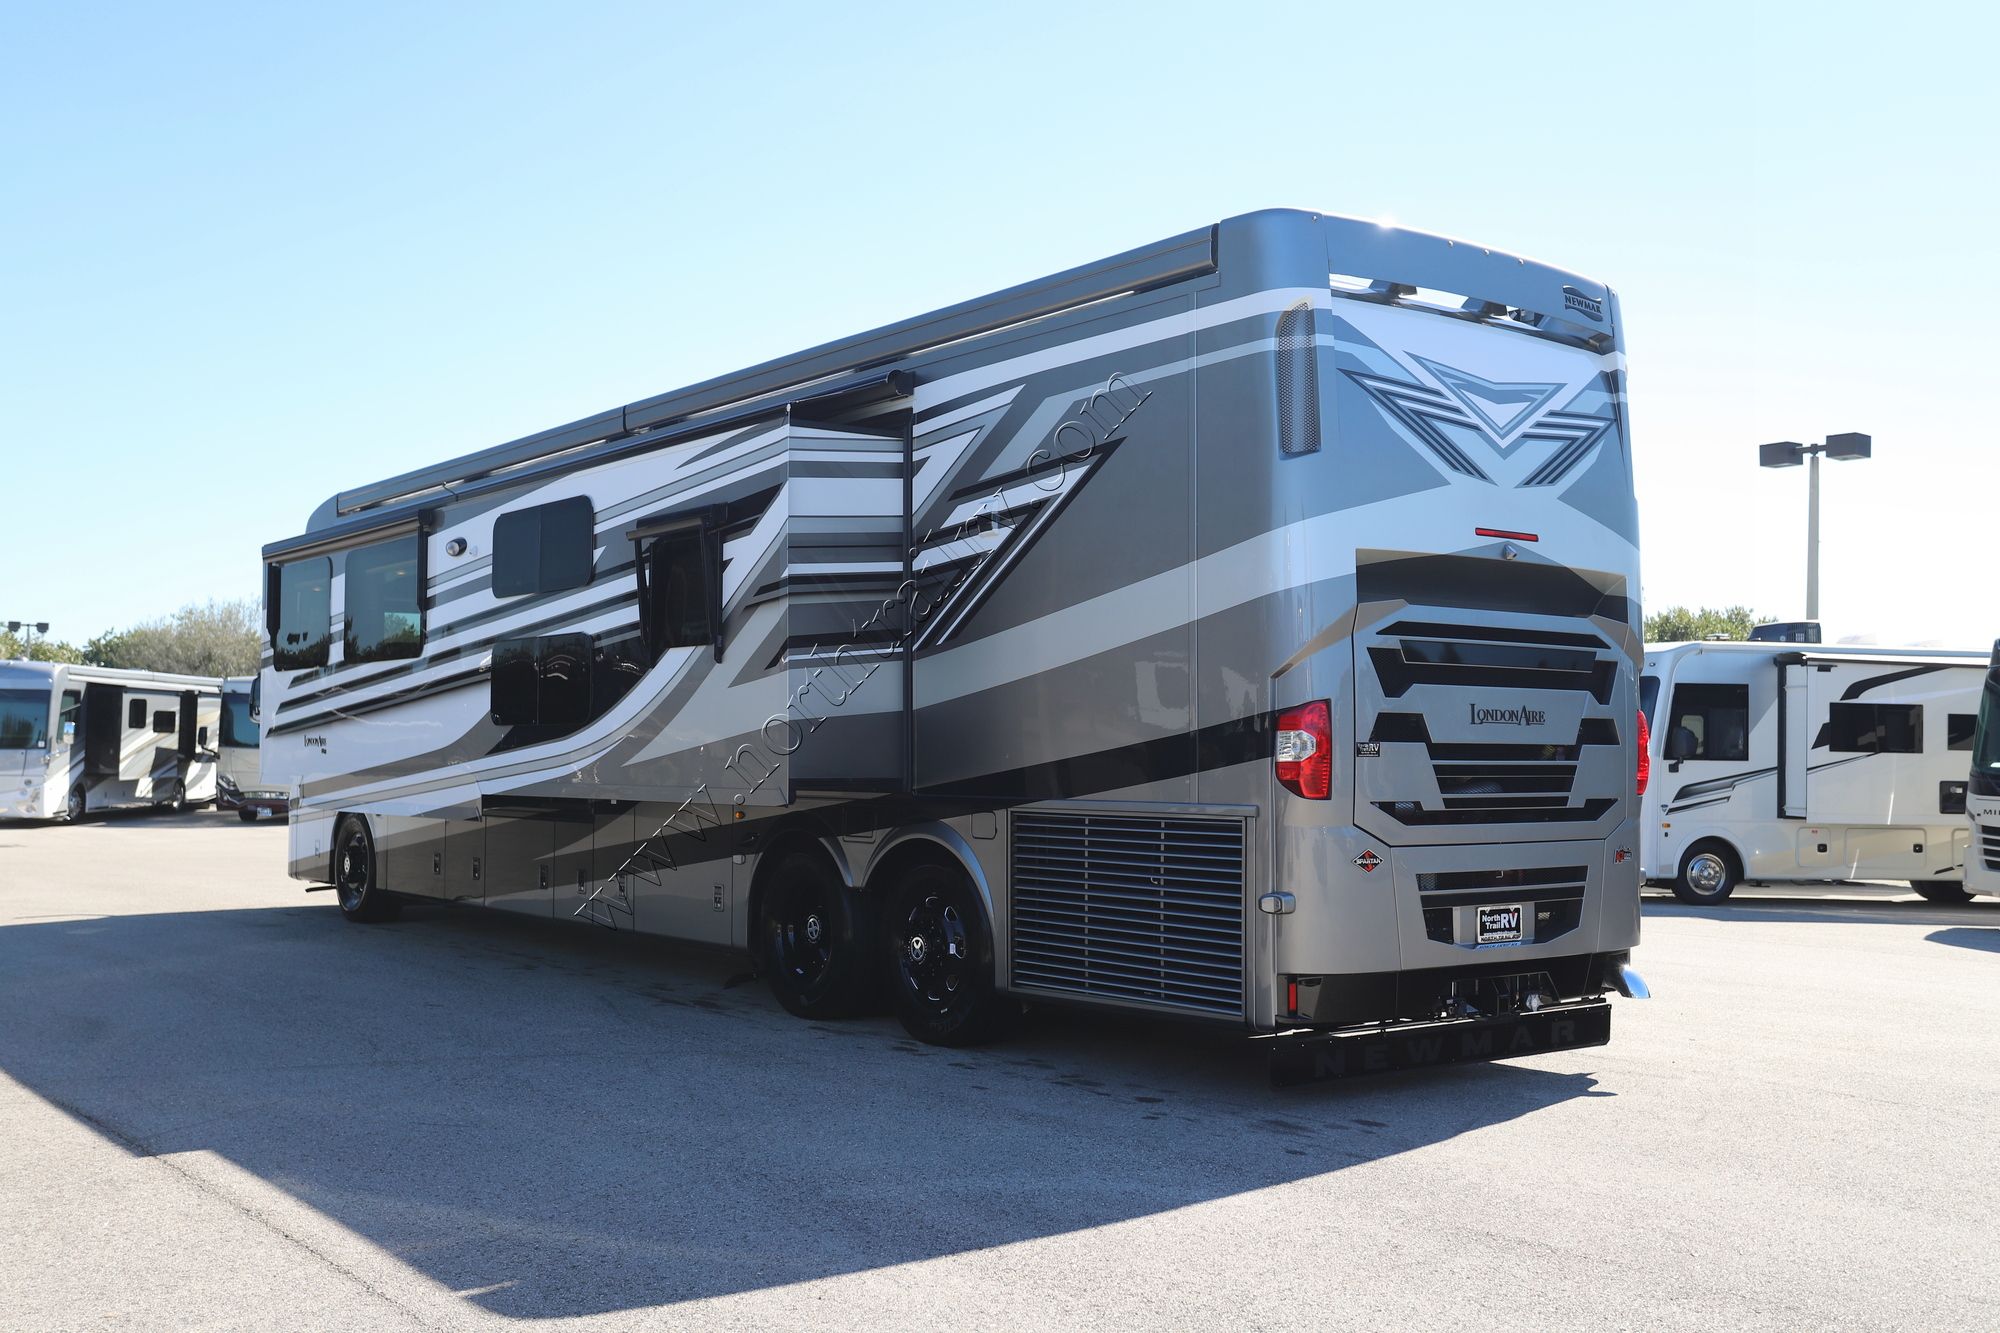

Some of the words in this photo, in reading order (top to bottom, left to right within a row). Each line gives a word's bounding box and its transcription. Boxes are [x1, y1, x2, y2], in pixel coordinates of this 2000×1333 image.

[1564, 294, 1602, 315] NEWMAR
[1482, 914, 1500, 922] North
[1501, 912, 1518, 928] RV
[1315, 1019, 1576, 1079] NEWMAR
